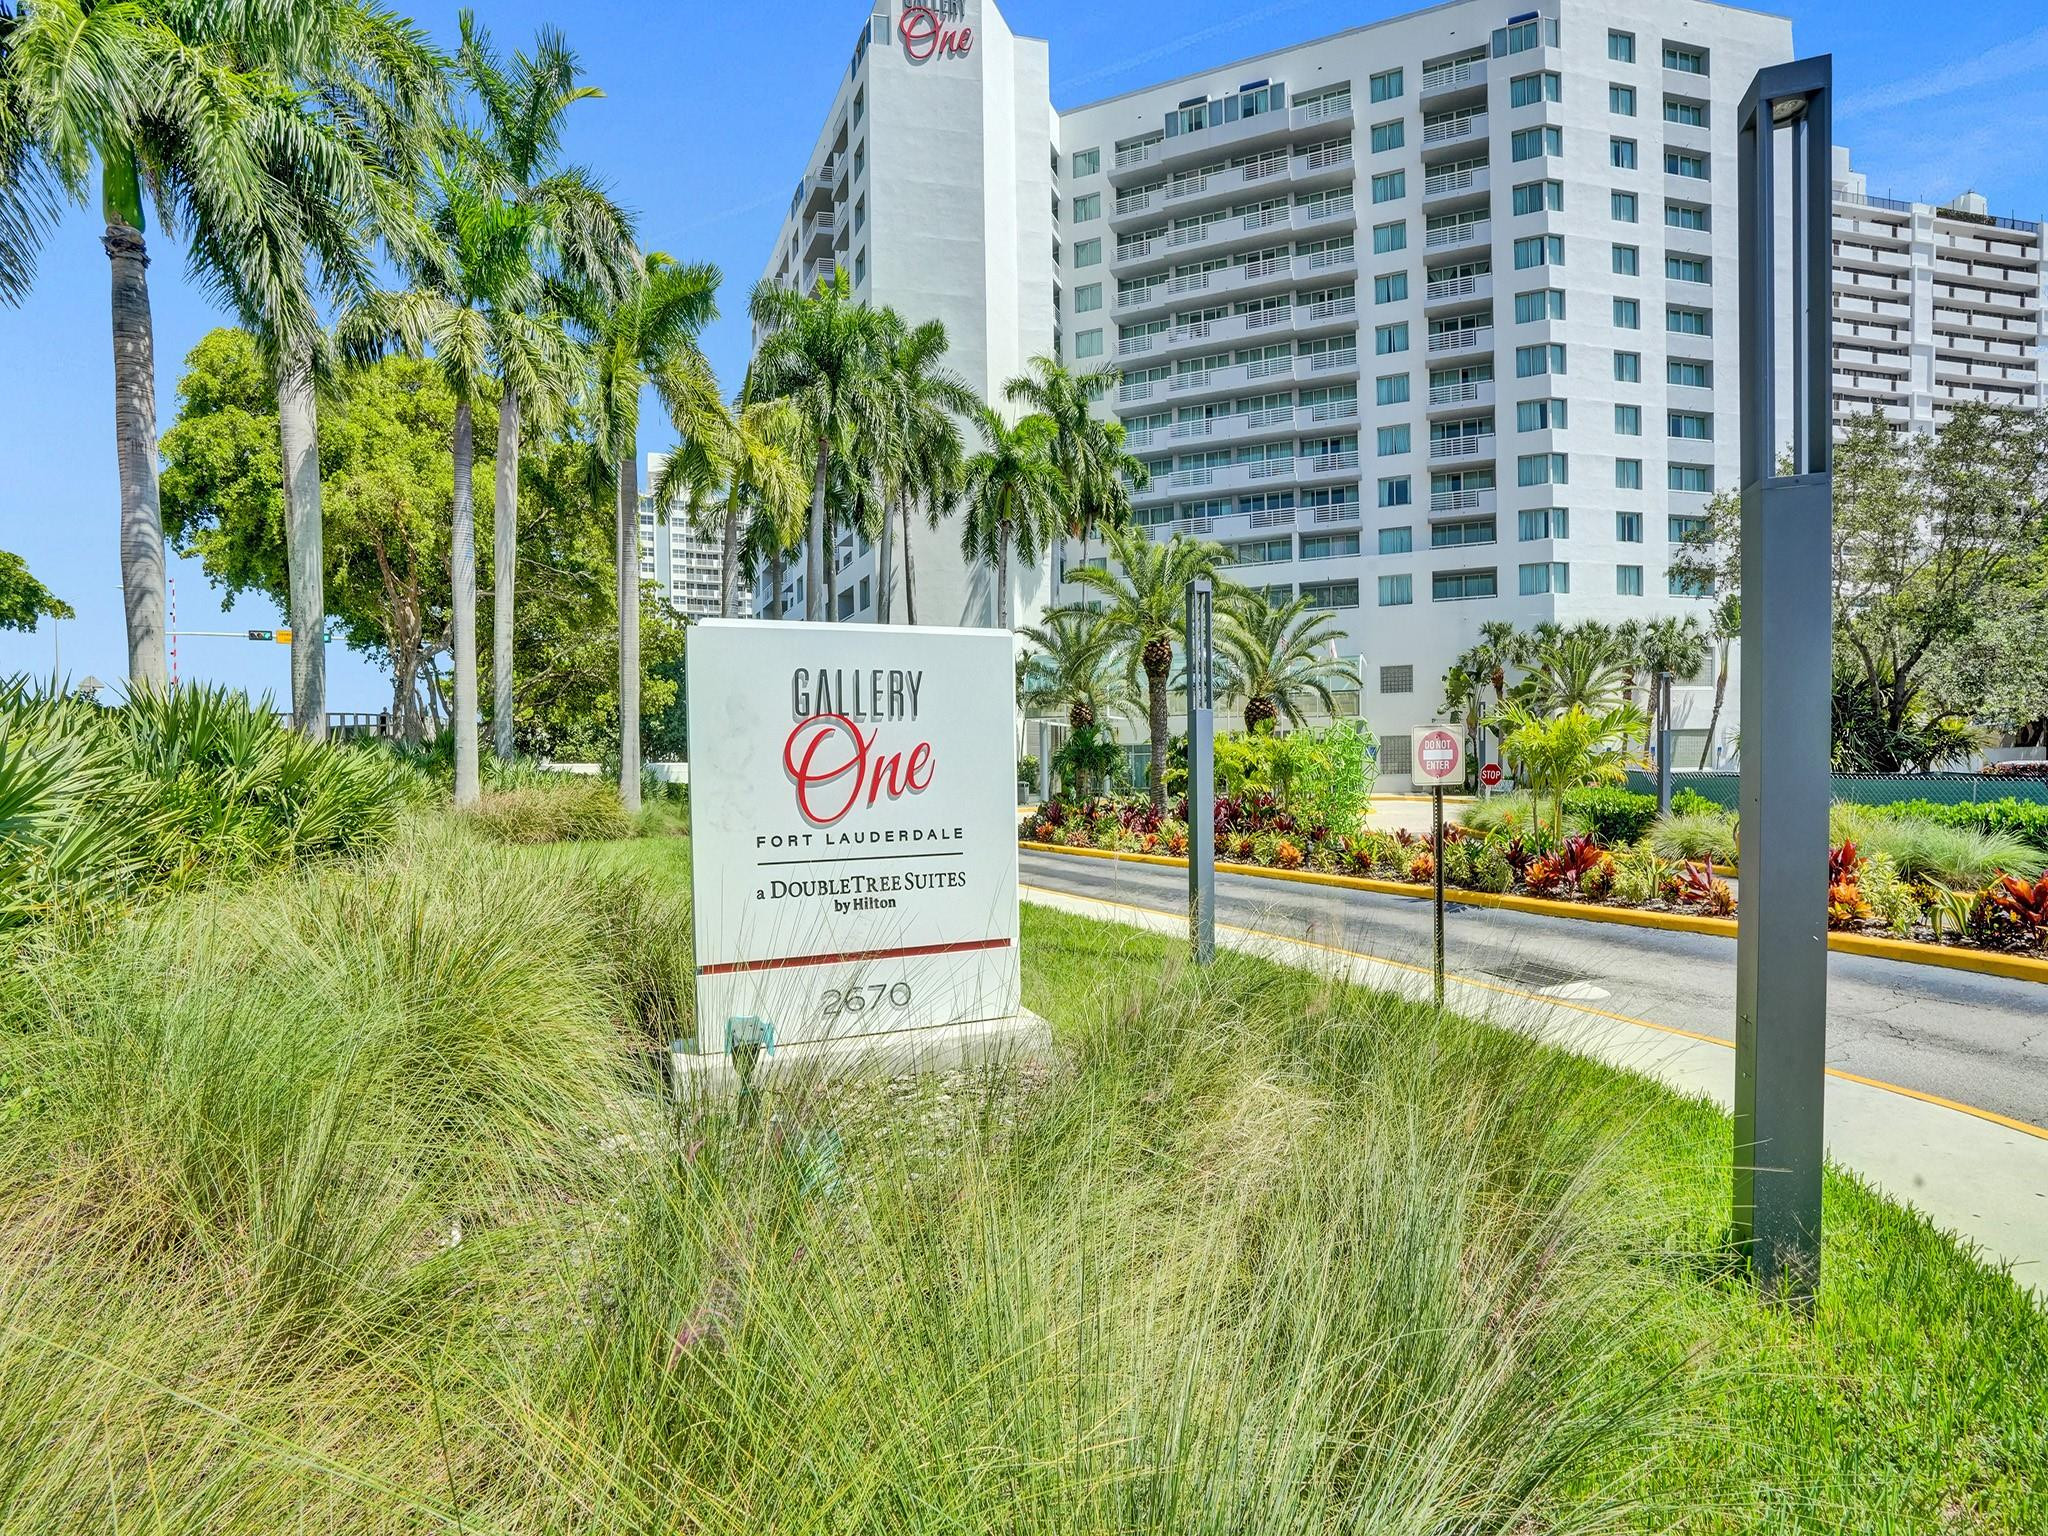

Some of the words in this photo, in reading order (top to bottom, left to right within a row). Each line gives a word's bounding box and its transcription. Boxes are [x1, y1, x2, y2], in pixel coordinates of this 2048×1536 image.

[899, 6, 973, 60] One
[793, 668, 923, 720] GALLERY
[1424, 740, 1435, 750] DO
[1436, 740, 1451, 749] NOT
[784, 713, 936, 824] One
[1426, 760, 1450, 770] ENTER
[1481, 771, 1501, 780] STOP
[756, 834, 813, 848] FORT
[826, 828, 963, 845] LAUDERDALE
[756, 889, 765, 899] a
[904, 872, 967, 891] SUITES
[834, 900, 851, 914] by
[853, 897, 897, 911] Hilton
[823, 982, 911, 1016] 2670
